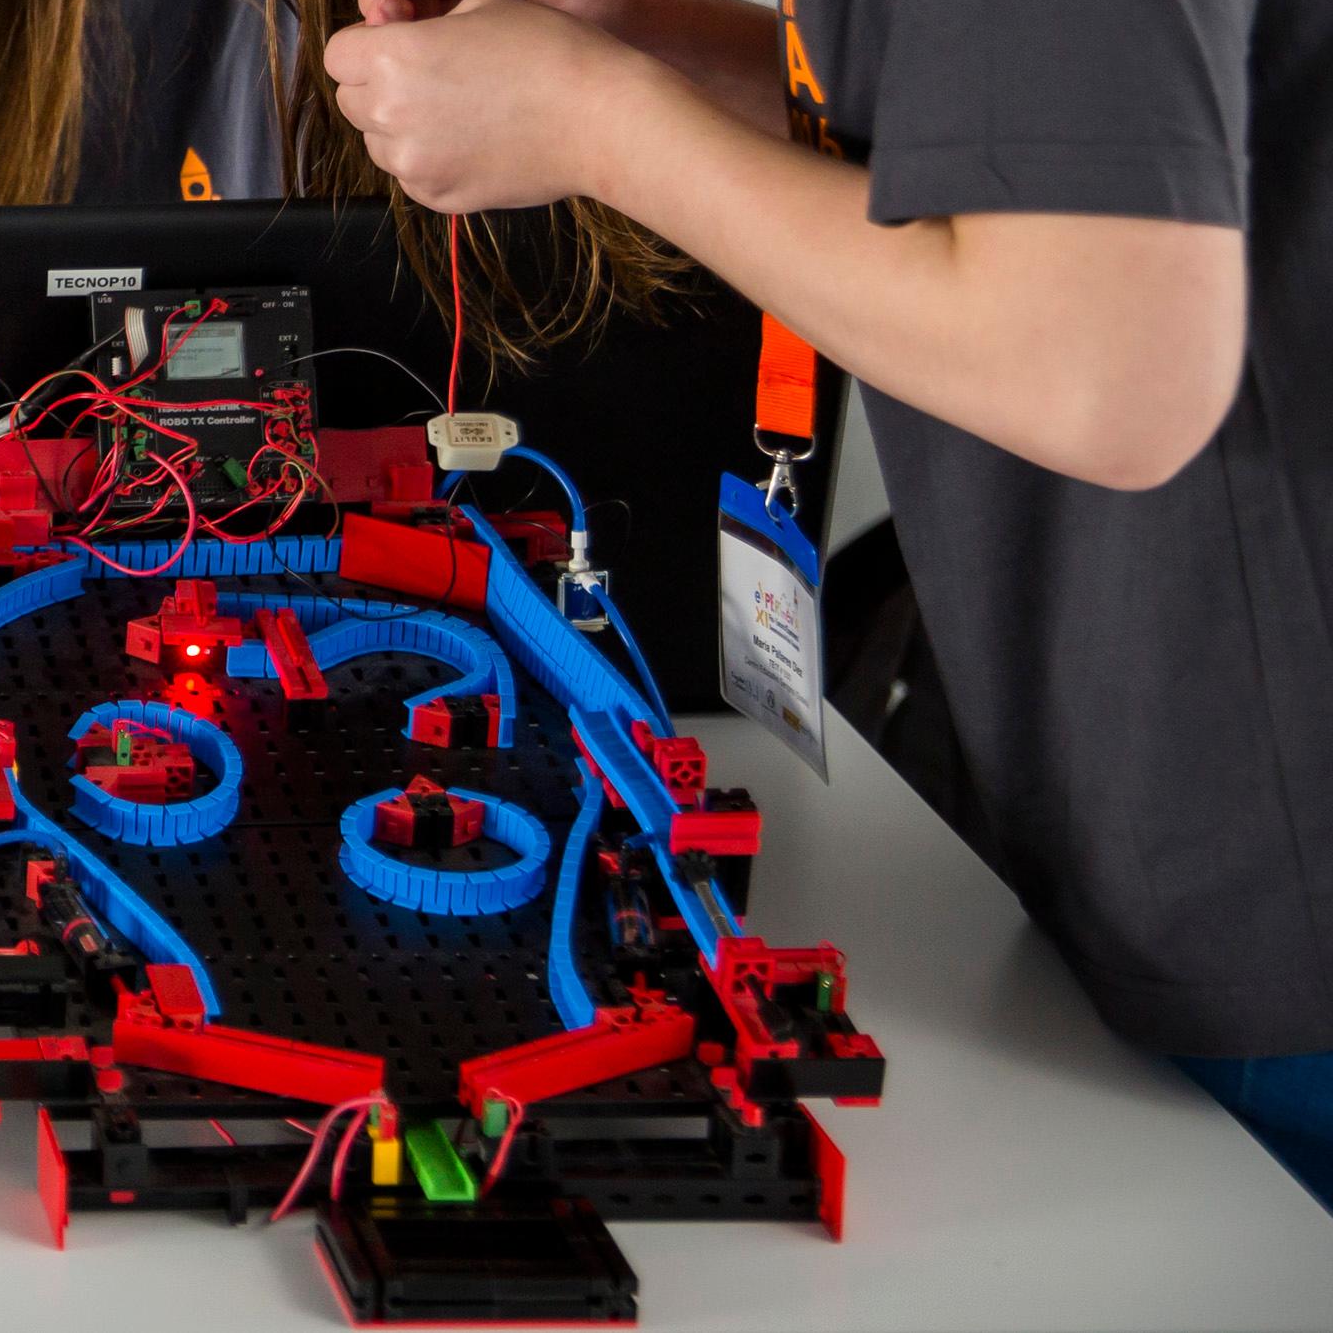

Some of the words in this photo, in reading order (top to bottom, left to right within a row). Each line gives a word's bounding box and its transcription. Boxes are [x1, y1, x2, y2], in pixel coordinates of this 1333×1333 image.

[54, 276, 137, 290] TECNOP10
[97, 296, 113, 304] USB
[159, 417, 189, 427] ROBO
[191, 416, 205, 425] TX
[207, 415, 256, 425] Controller
